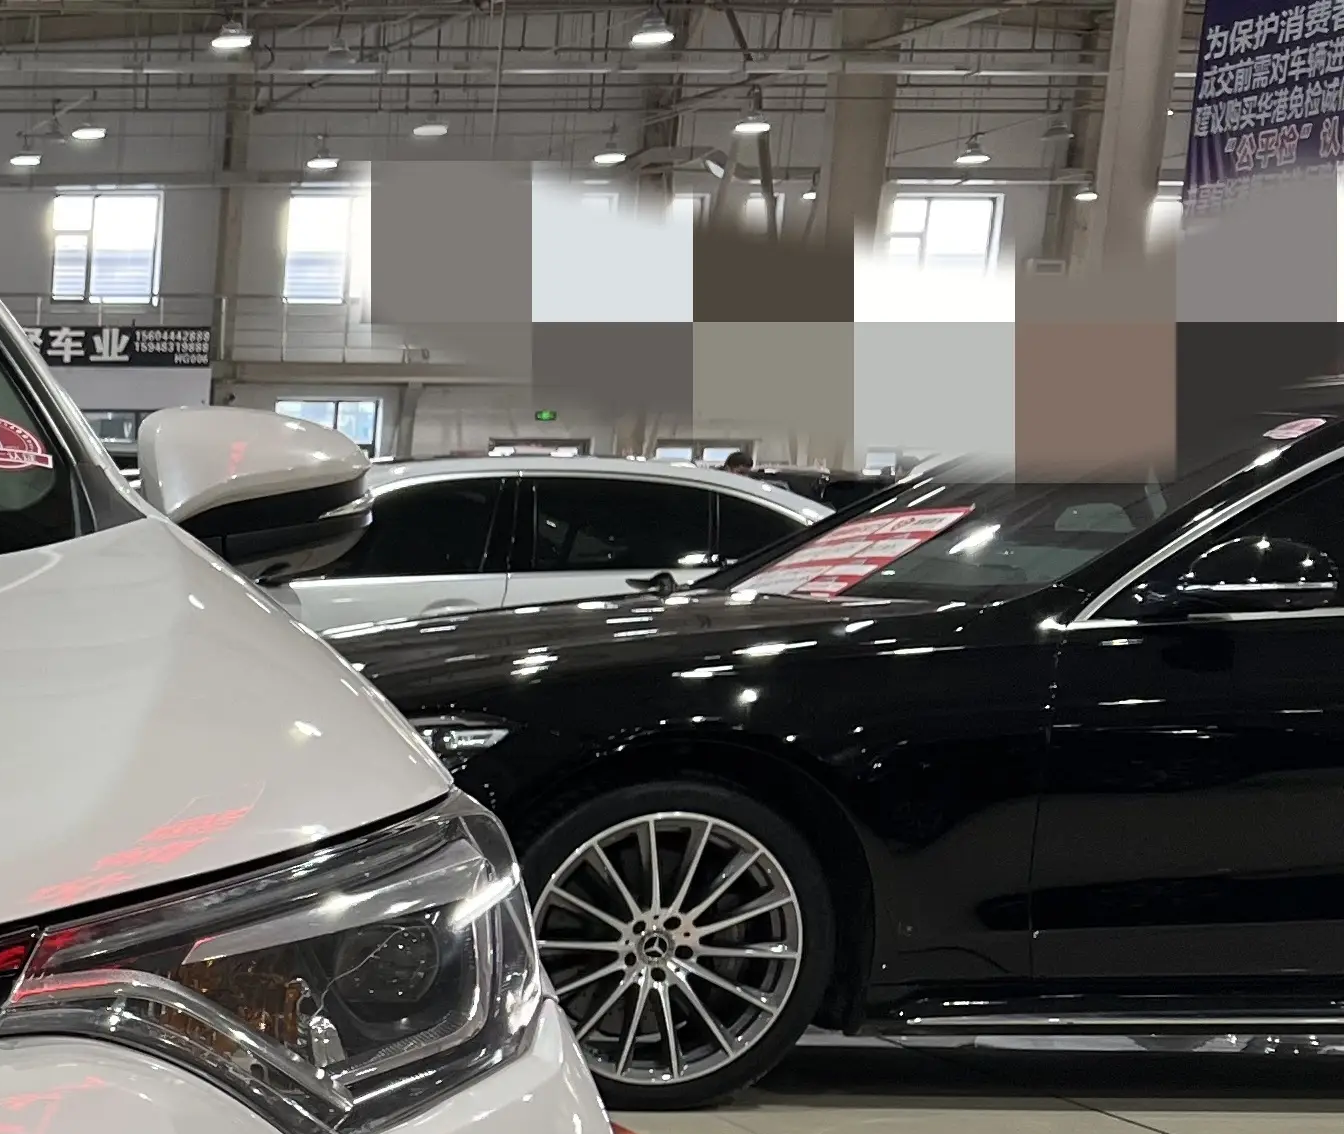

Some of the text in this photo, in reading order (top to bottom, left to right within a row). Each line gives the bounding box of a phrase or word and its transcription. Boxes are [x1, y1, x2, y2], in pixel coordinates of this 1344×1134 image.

[1194, 77, 1344, 137] 建议购买华港免检诚
